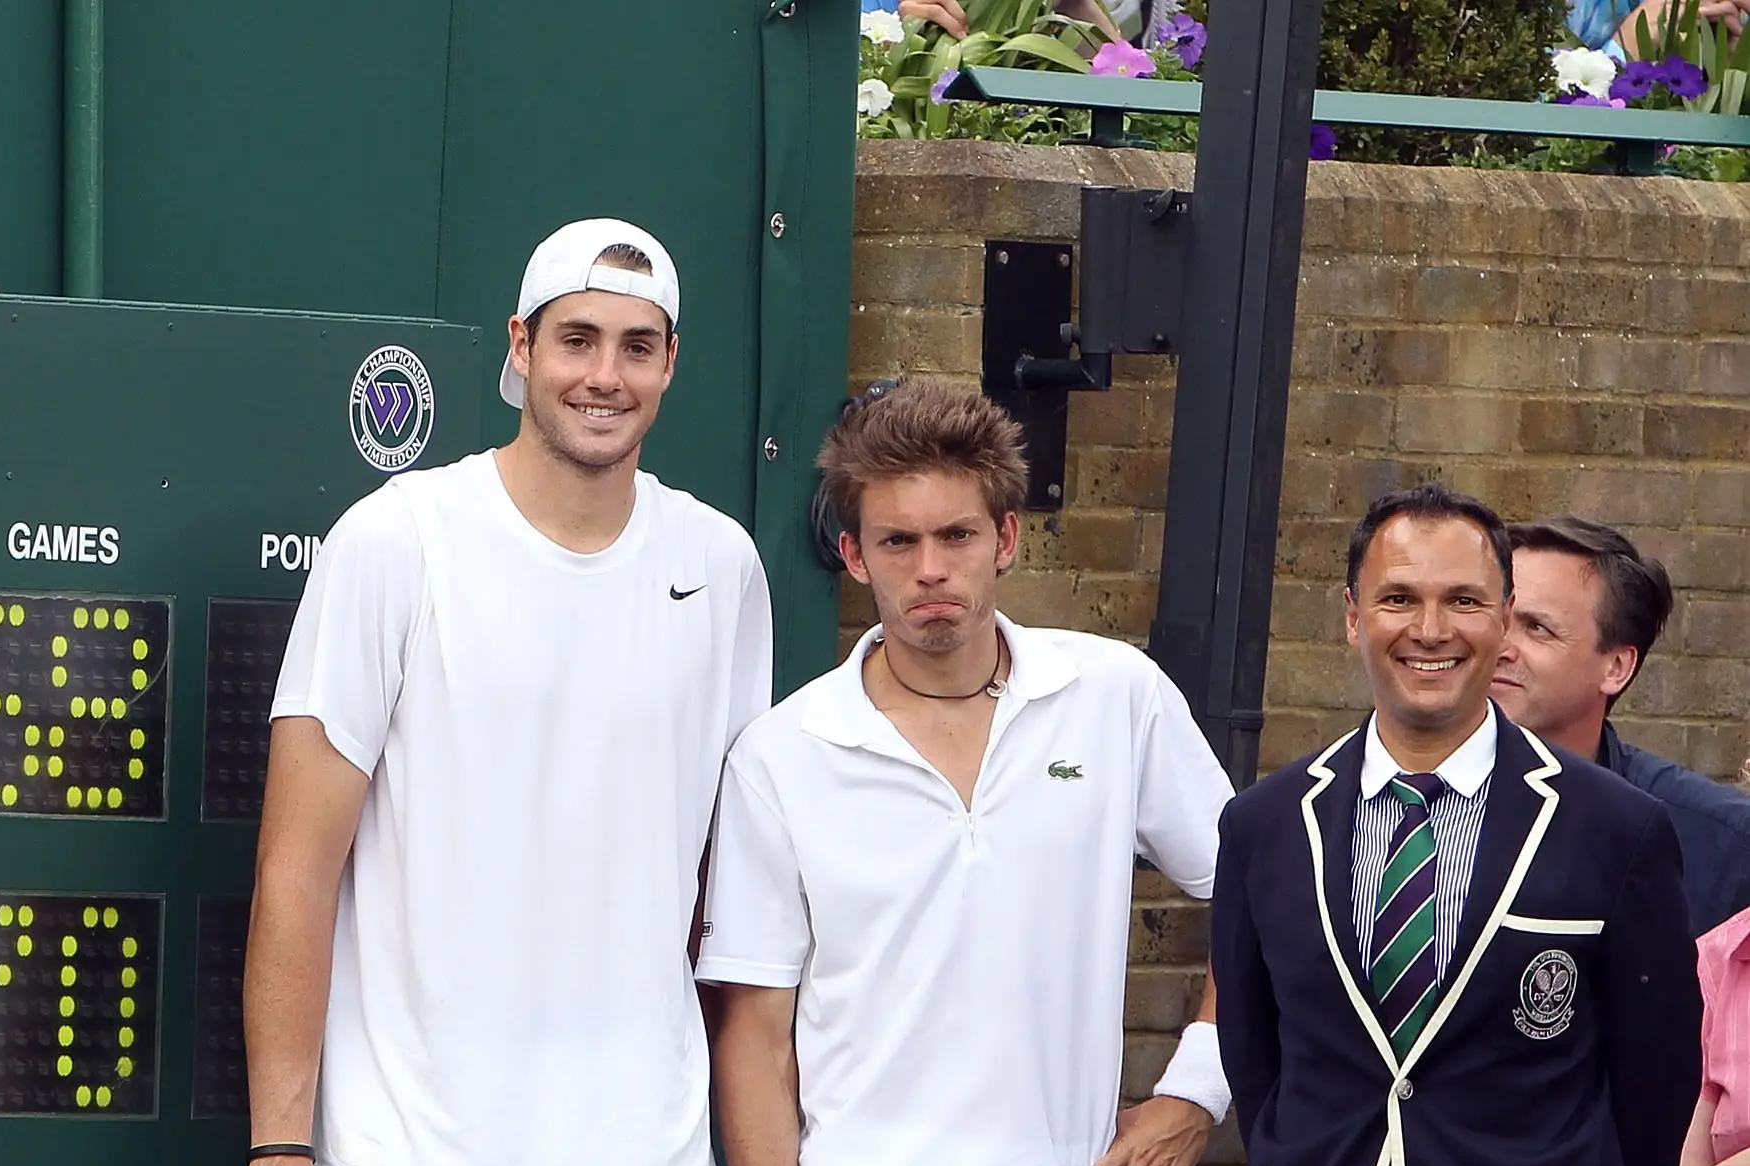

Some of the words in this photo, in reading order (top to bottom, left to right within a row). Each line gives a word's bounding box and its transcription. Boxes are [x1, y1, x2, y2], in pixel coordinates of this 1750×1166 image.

[353, 376, 366, 405] THE
[364, 350, 431, 411] CHAMPIONSHIPS
[360, 434, 422, 467] WIMBLEDON
[8, 522, 119, 564] GAMES
